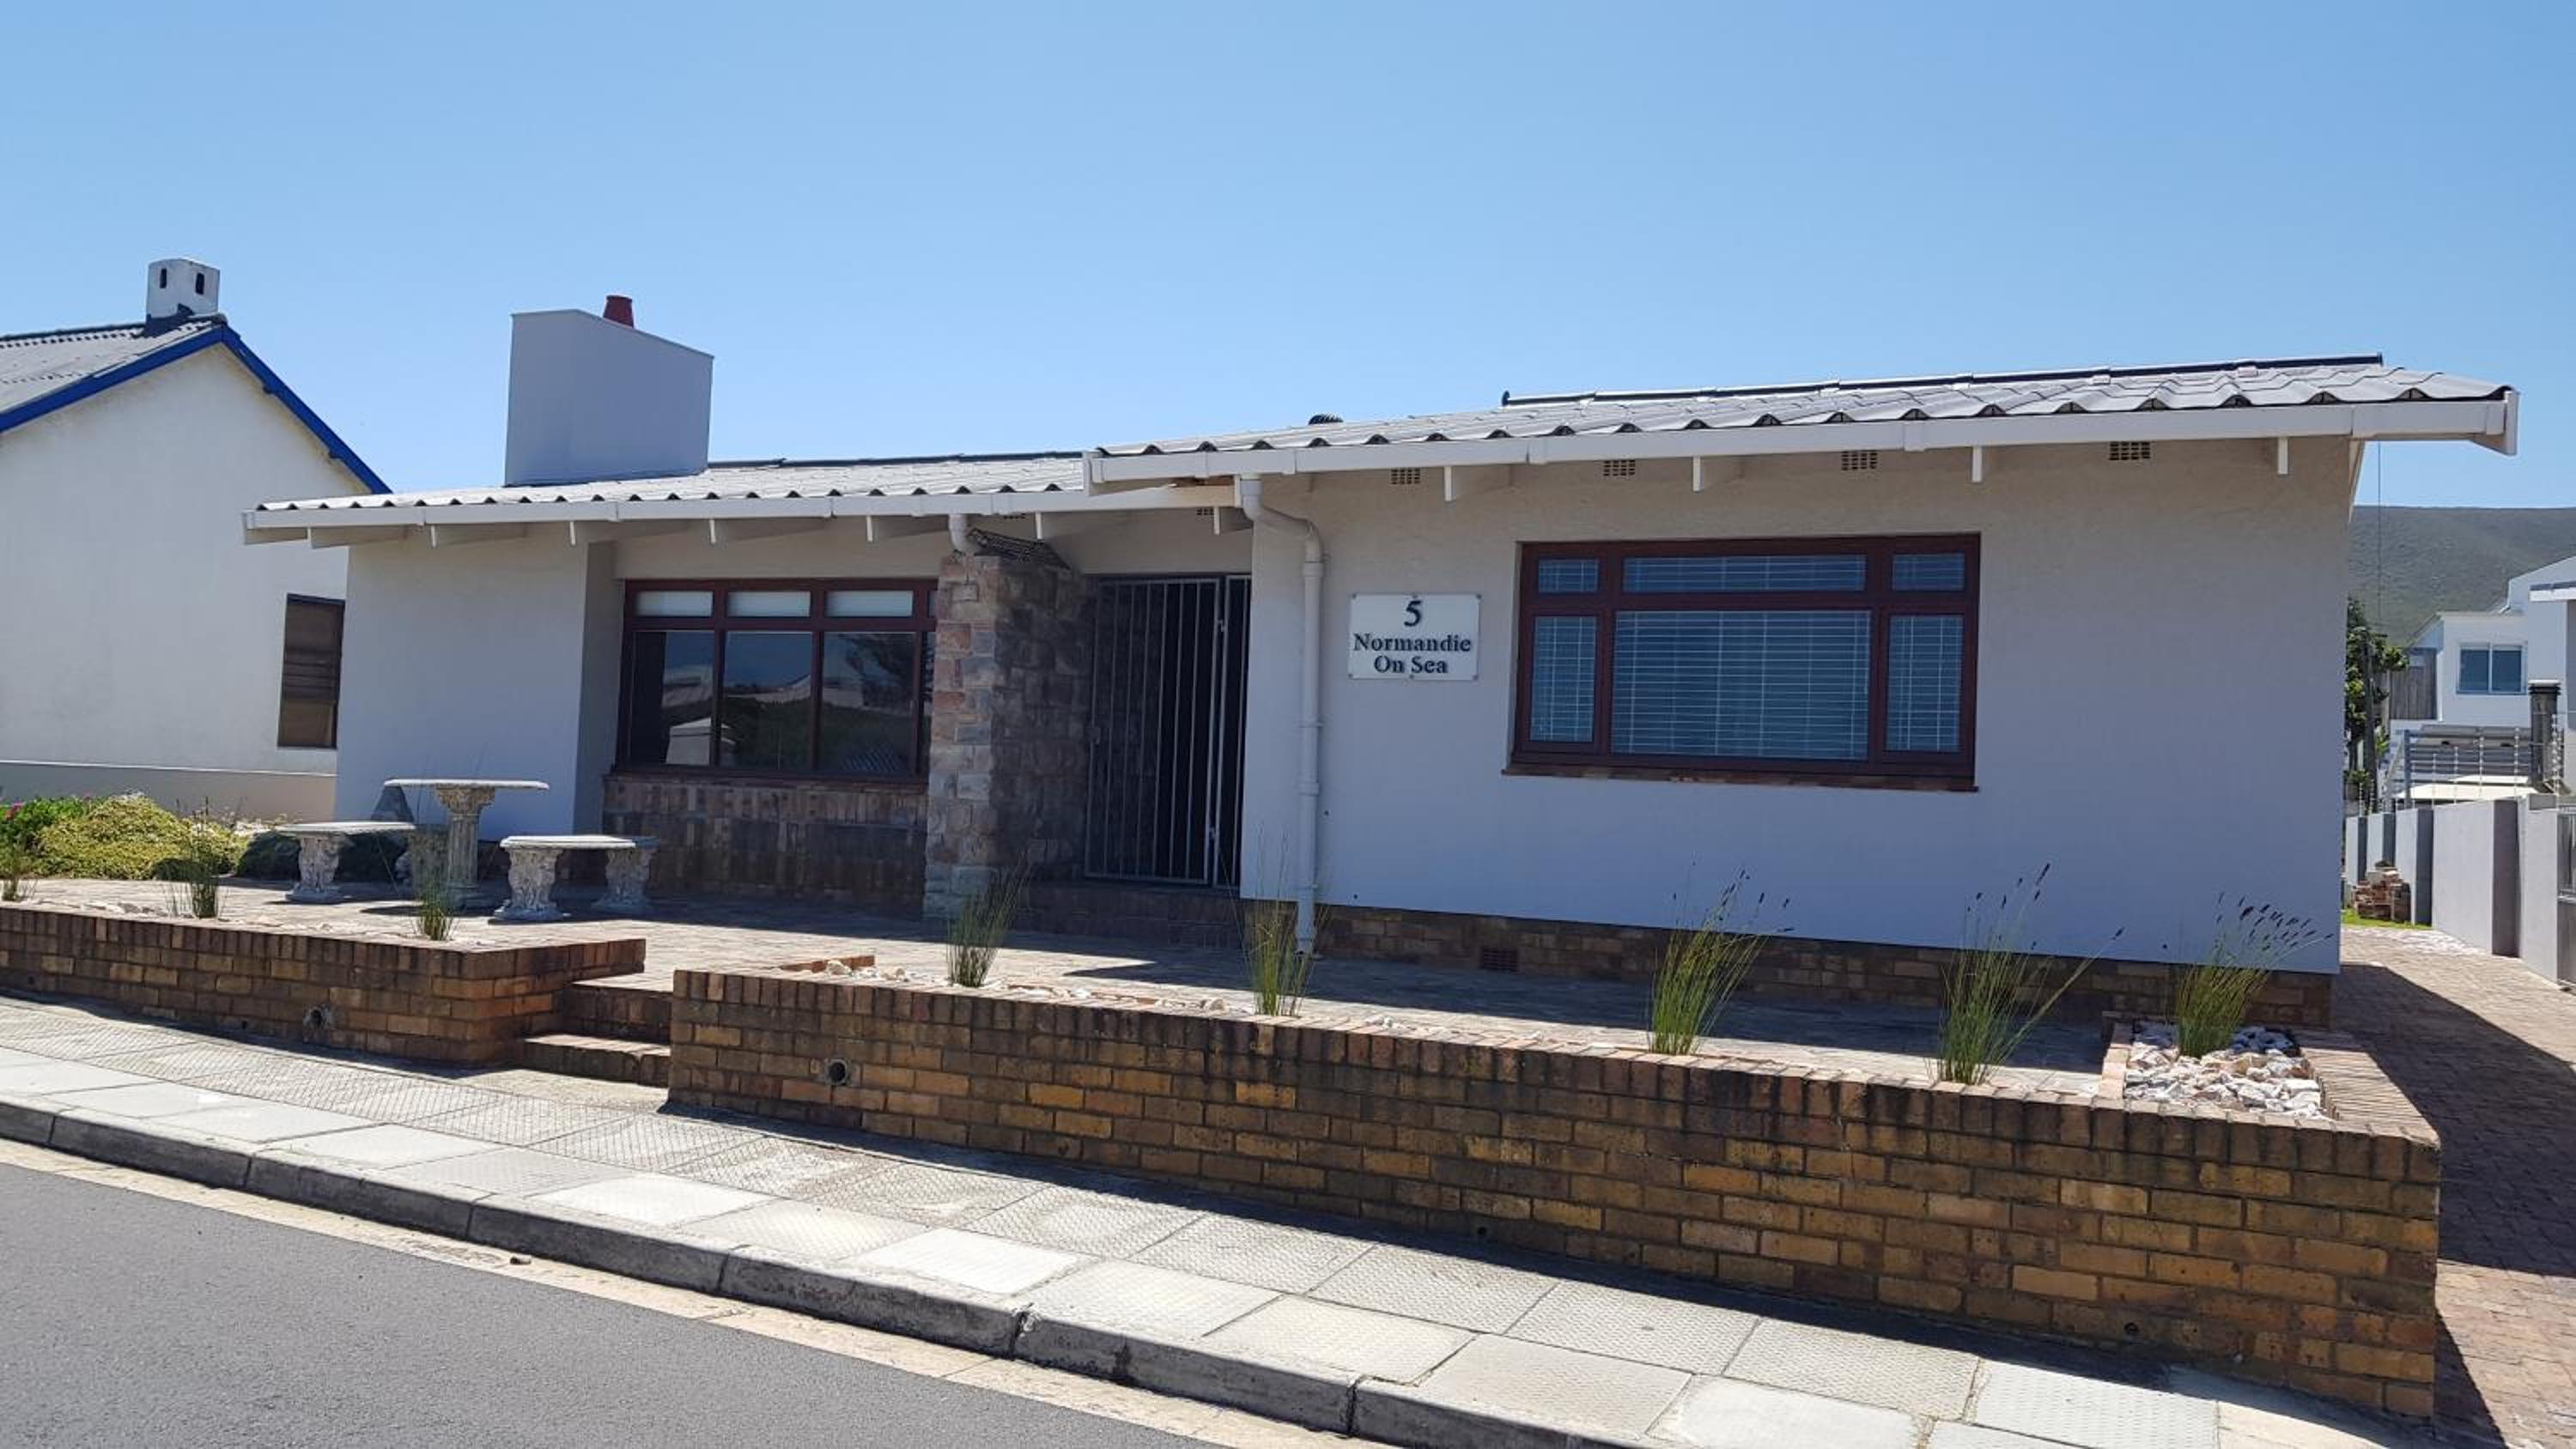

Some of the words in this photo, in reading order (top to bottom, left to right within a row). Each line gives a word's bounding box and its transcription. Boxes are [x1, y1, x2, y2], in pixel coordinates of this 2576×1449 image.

[1404, 599, 1422, 627] 5
[1353, 633, 1471, 652] Normandie
[1374, 655, 1405, 673] On
[1411, 655, 1448, 674] Sea
